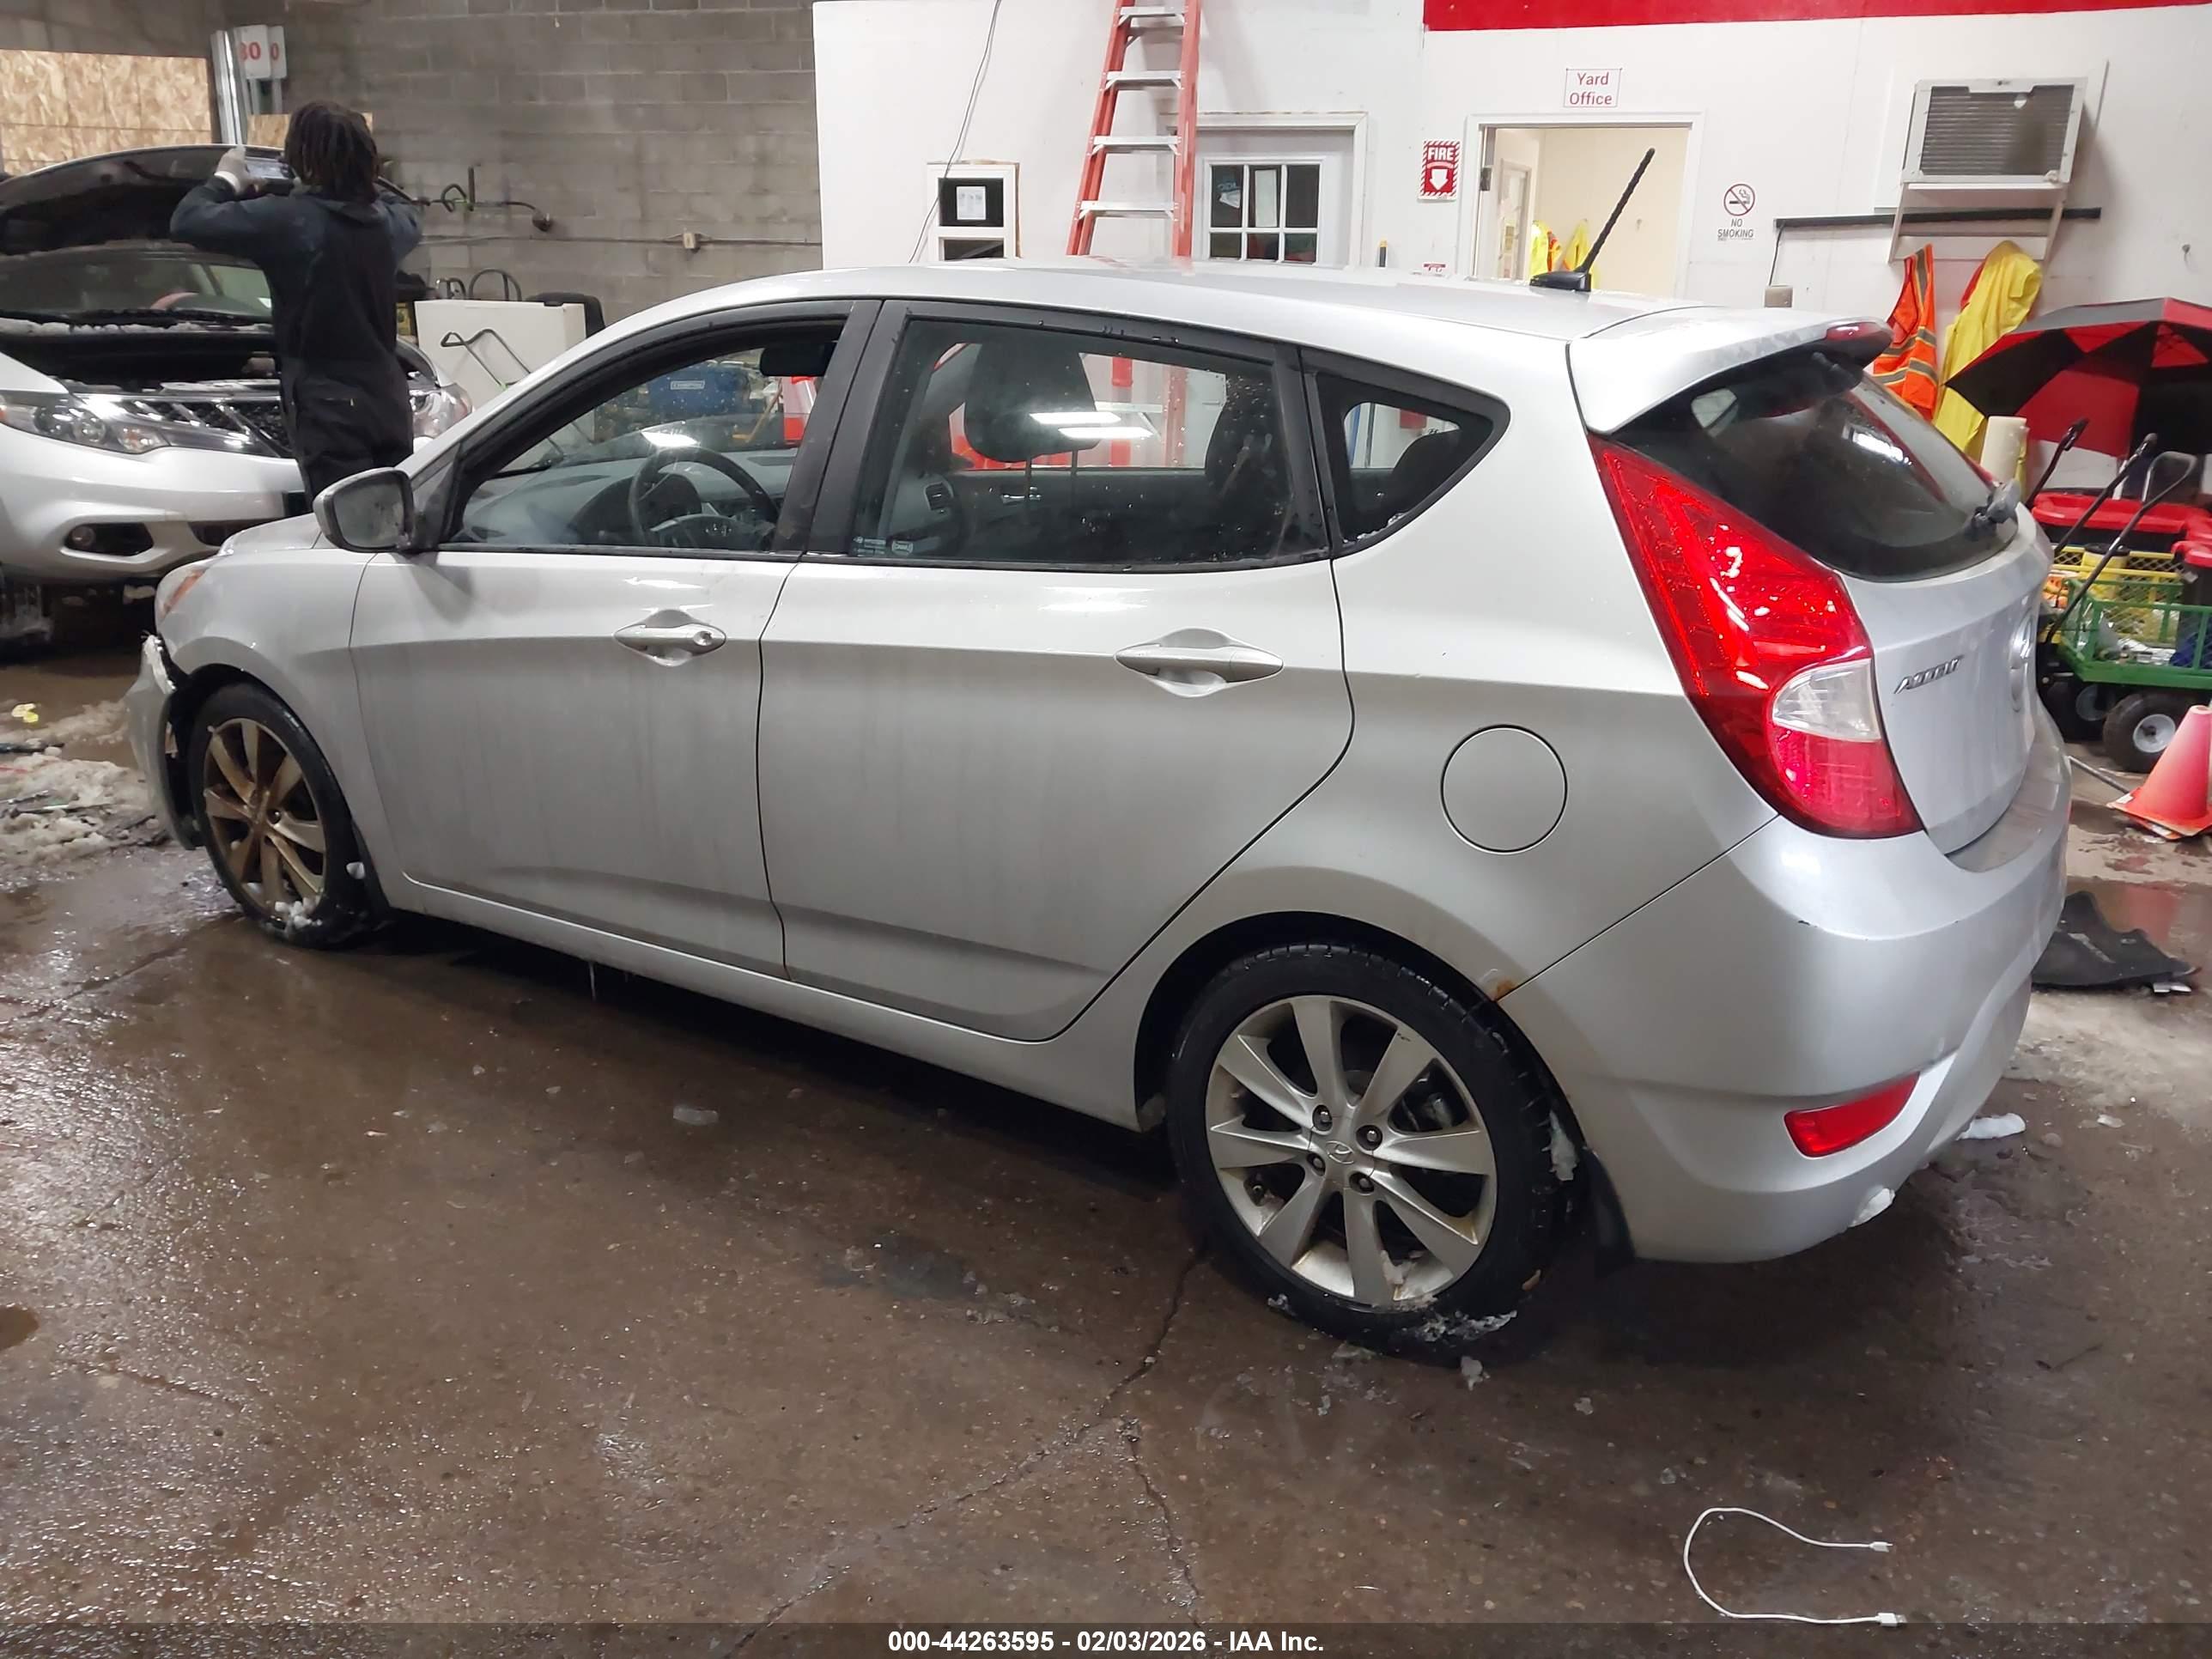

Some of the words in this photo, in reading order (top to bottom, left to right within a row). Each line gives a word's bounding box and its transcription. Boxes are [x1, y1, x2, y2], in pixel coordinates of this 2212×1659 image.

[1577, 71, 1609, 86] Yard
[1570, 91, 1613, 105] Office
[1427, 147, 1455, 161] FIRE
[1731, 218, 1743, 228] NO
[1717, 228, 1753, 238] SMOKING
